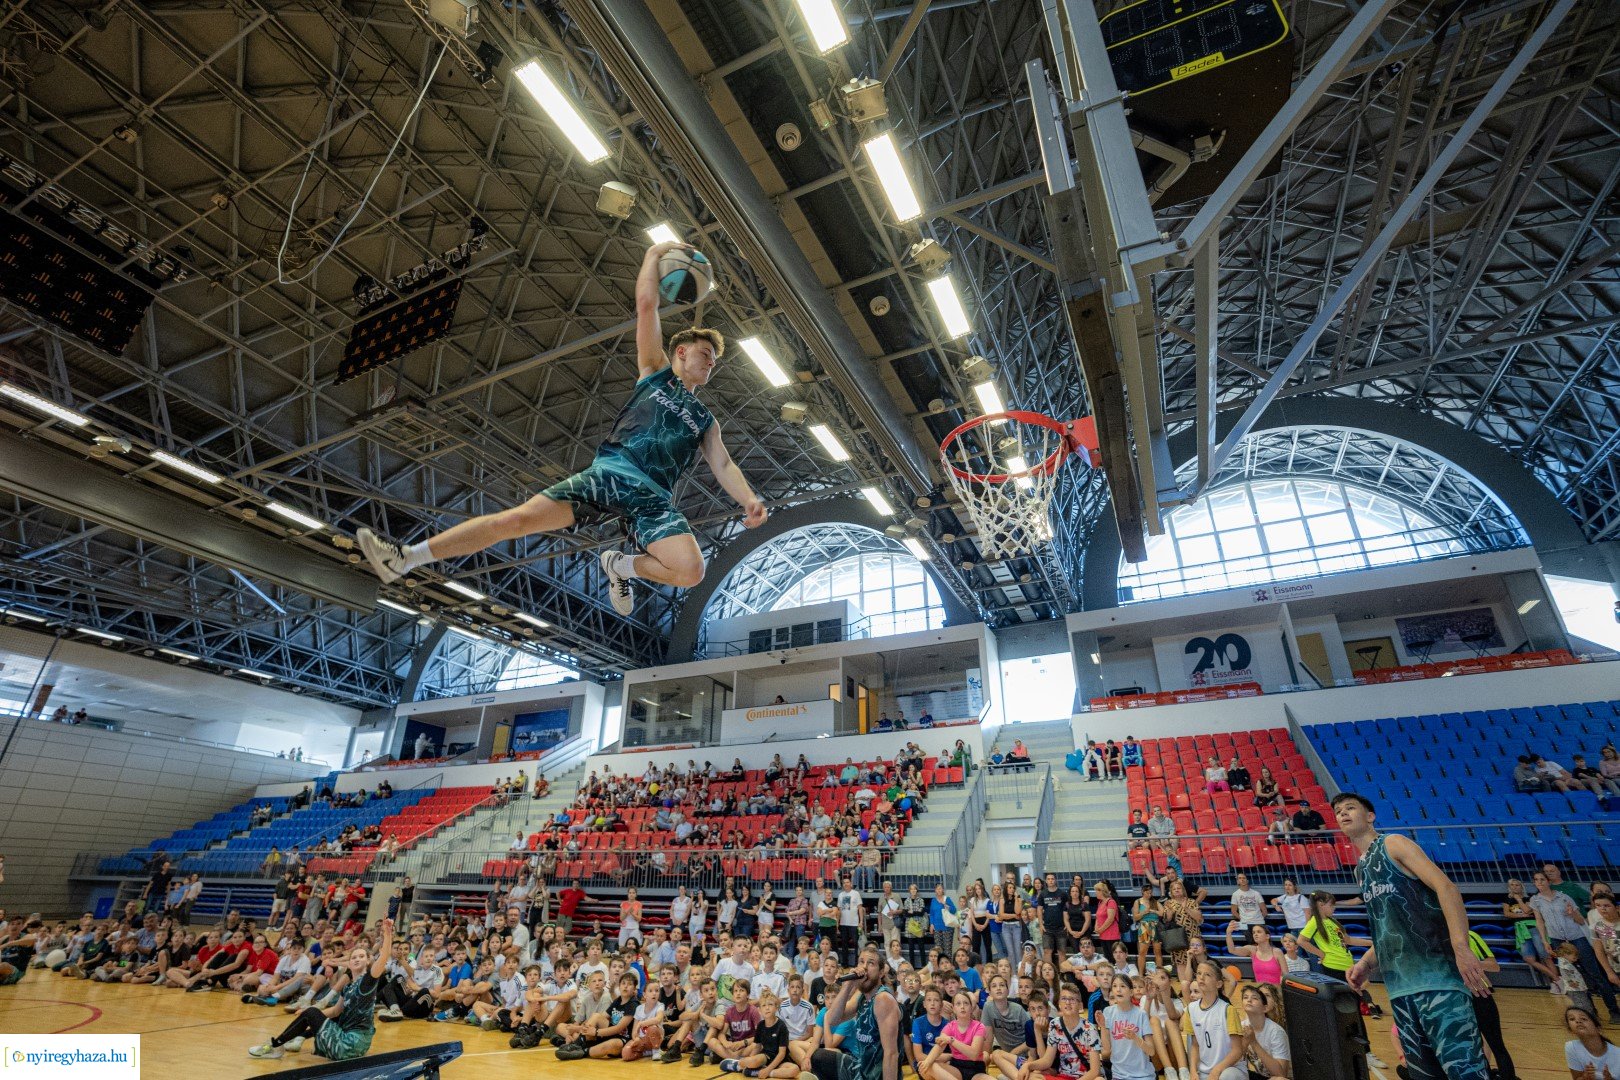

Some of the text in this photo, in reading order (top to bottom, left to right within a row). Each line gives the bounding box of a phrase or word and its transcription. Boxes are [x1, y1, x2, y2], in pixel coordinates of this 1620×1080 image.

[1175, 56, 1221, 77] Bodet
[649, 389, 700, 438] Face Team
[1273, 583, 1313, 594] Eissmann
[1184, 633, 1252, 674] 20
[1212, 668, 1252, 679] Eissmann
[745, 705, 799, 722] Continental
[1205, 1031, 1212, 1048] 0
